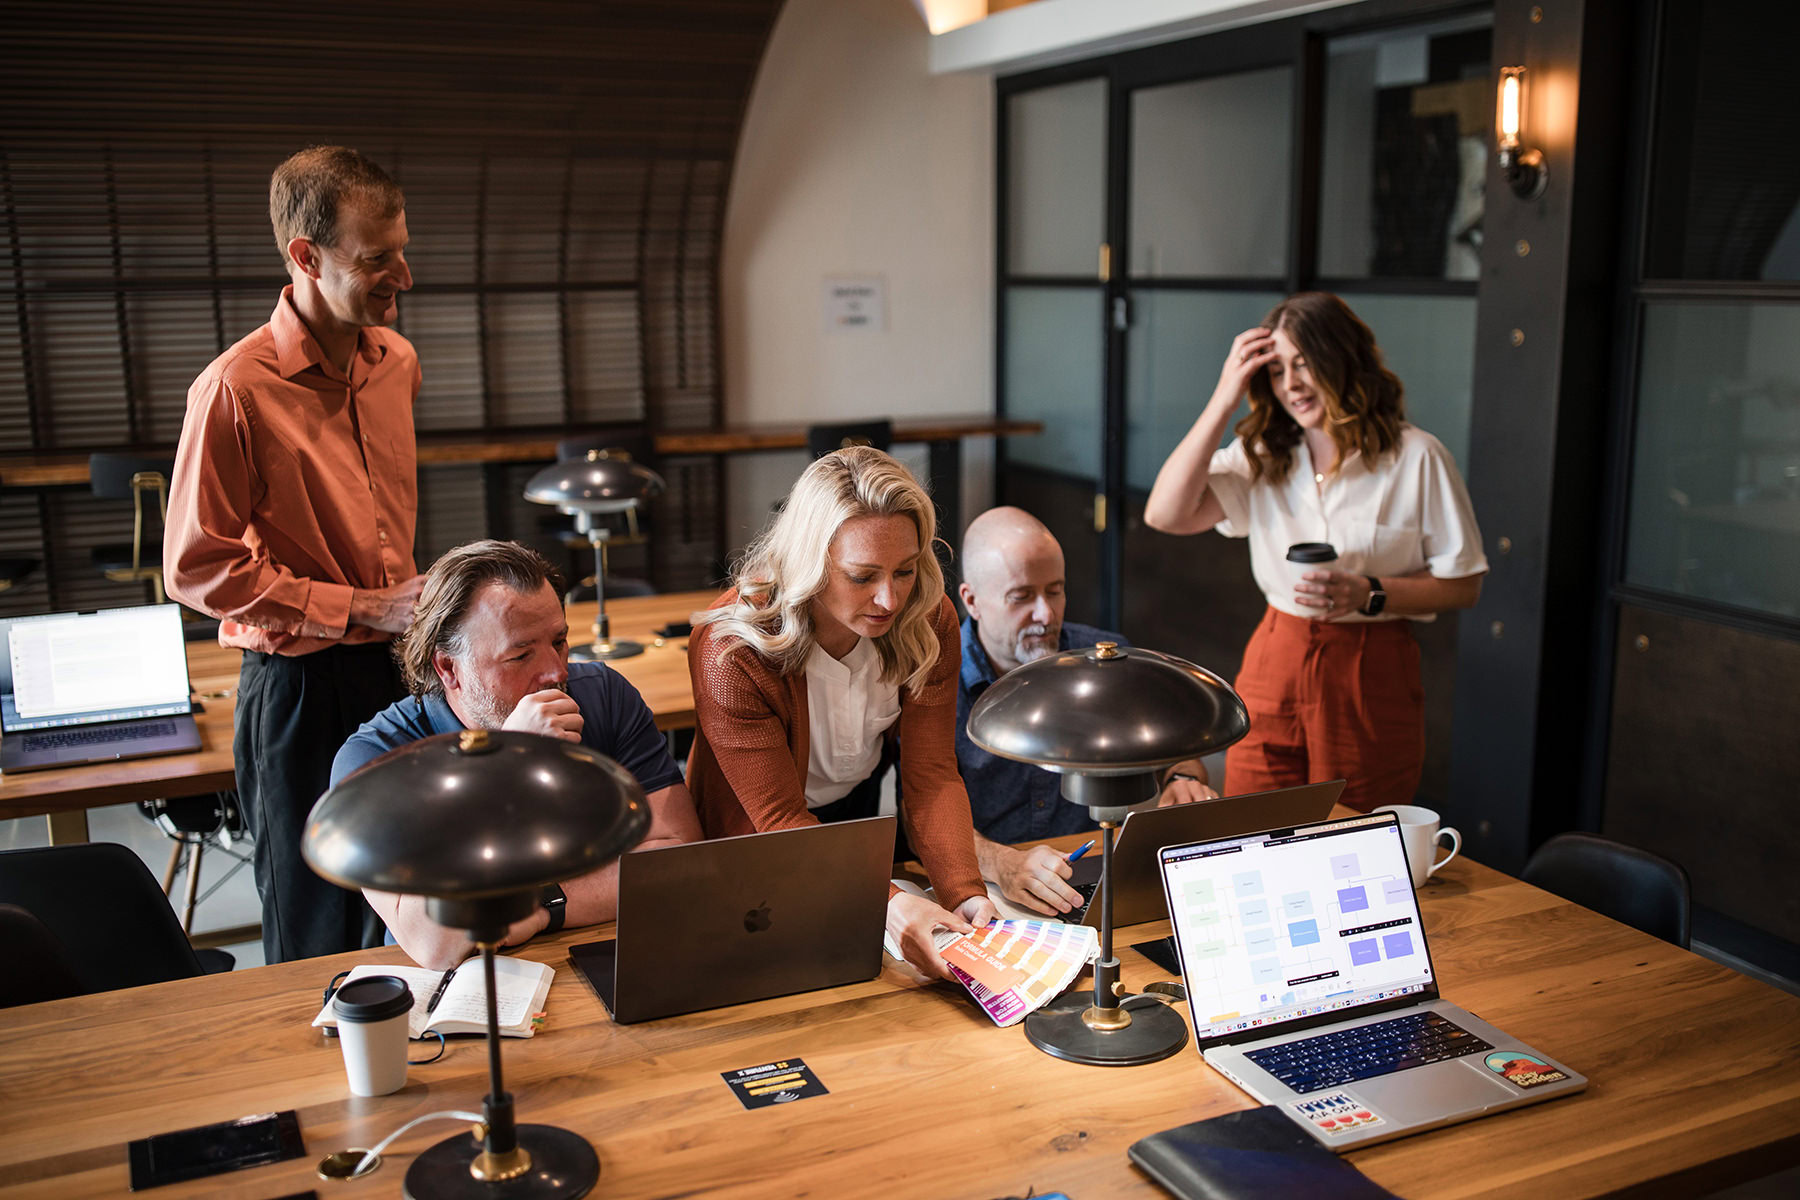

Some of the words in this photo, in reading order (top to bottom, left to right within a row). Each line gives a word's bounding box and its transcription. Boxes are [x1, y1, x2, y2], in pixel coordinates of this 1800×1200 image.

[960, 940, 988, 959] FORMULA
[985, 956, 1007, 971] GUIDE
[1509, 1071, 1539, 1082] Stay
[1517, 1072, 1563, 1086] Golden
[1307, 1111, 1332, 1120] KIA
[1332, 1104, 1362, 1115] ORA
